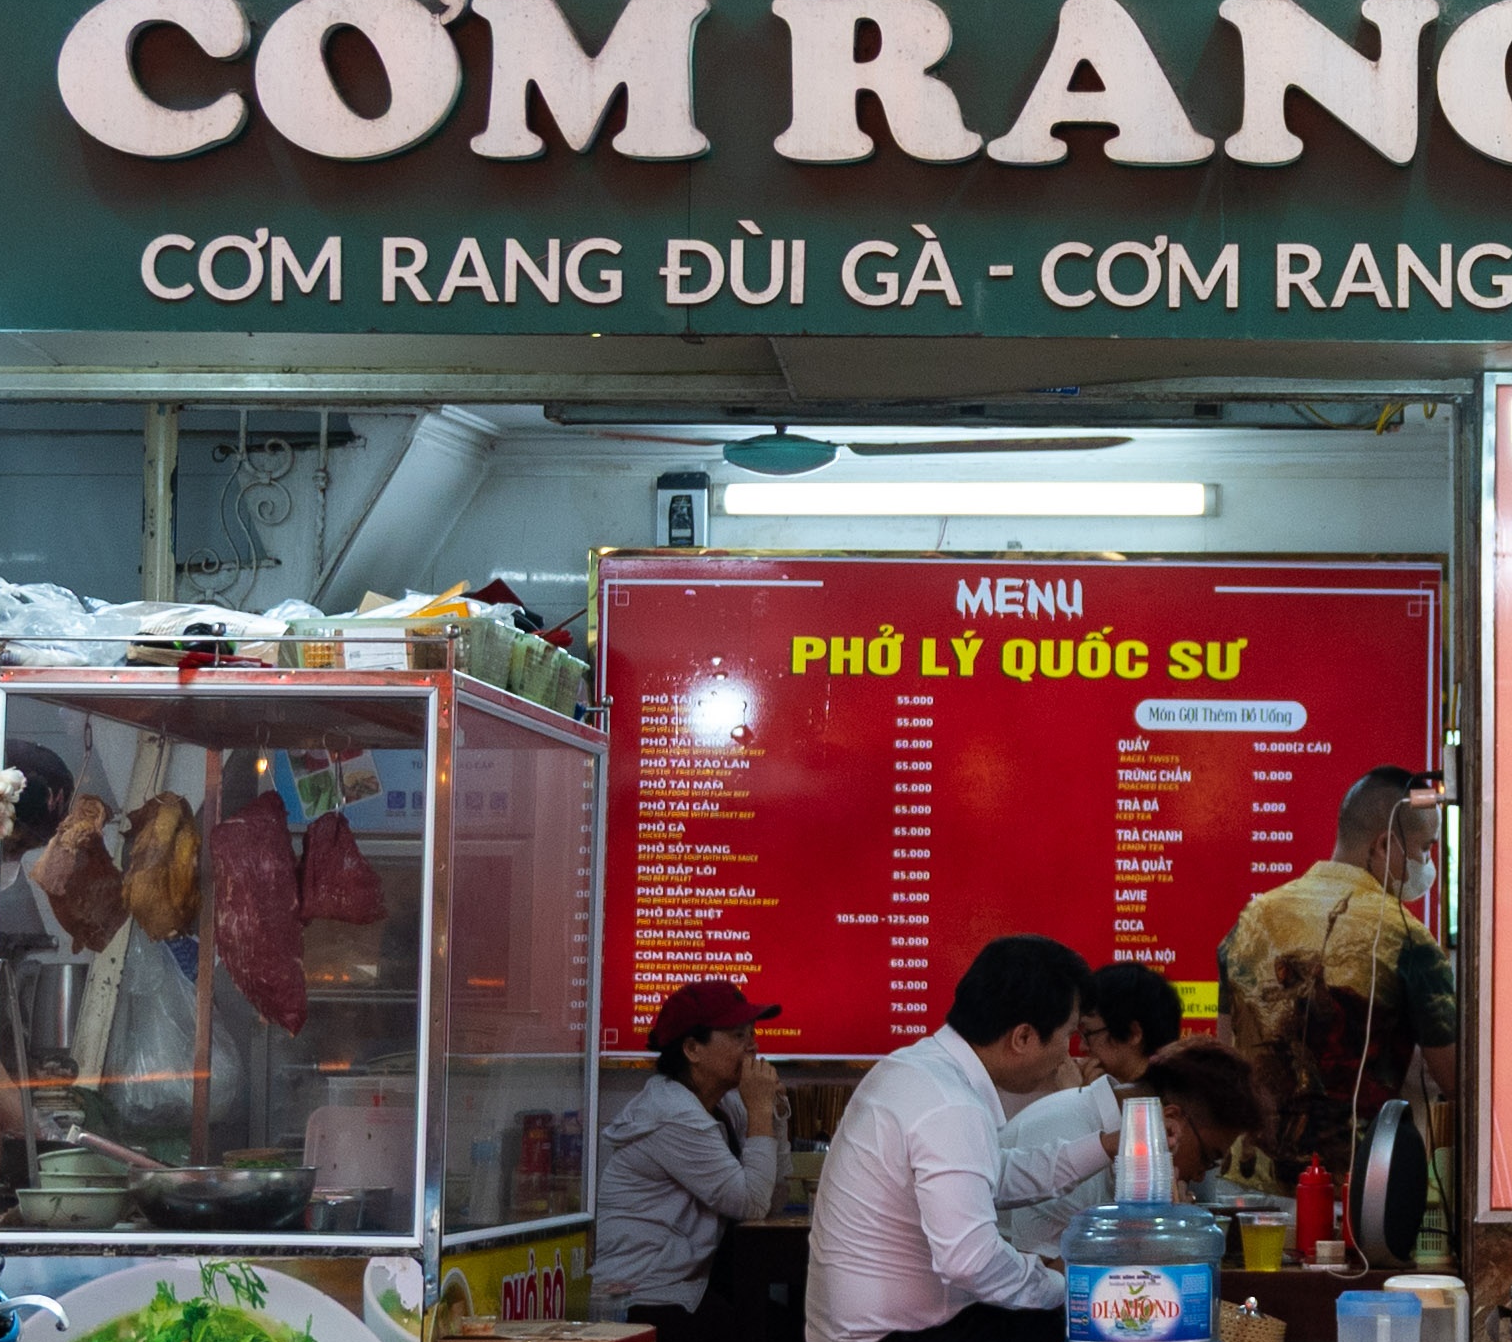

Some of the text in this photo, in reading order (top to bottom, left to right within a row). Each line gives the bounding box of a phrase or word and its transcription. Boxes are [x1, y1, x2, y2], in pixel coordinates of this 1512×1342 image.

[140, 226, 342, 302] CƠM
[381, 236, 623, 304] RANG
[658, 219, 806, 305] ĐÙI
[841, 223, 963, 307] GÀ
[1040, 234, 1240, 309] CƠM
[956, 576, 1083, 621] MENU
[791, 624, 1248, 682] PHỞ LÝ QUỐC SƯ
[1252, 802, 1286, 813] 5.000
[1115, 889, 1147, 902] LAVIE
[1114, 919, 1145, 932] COCA
[1090, 1298, 1181, 1320] DIAMOND
